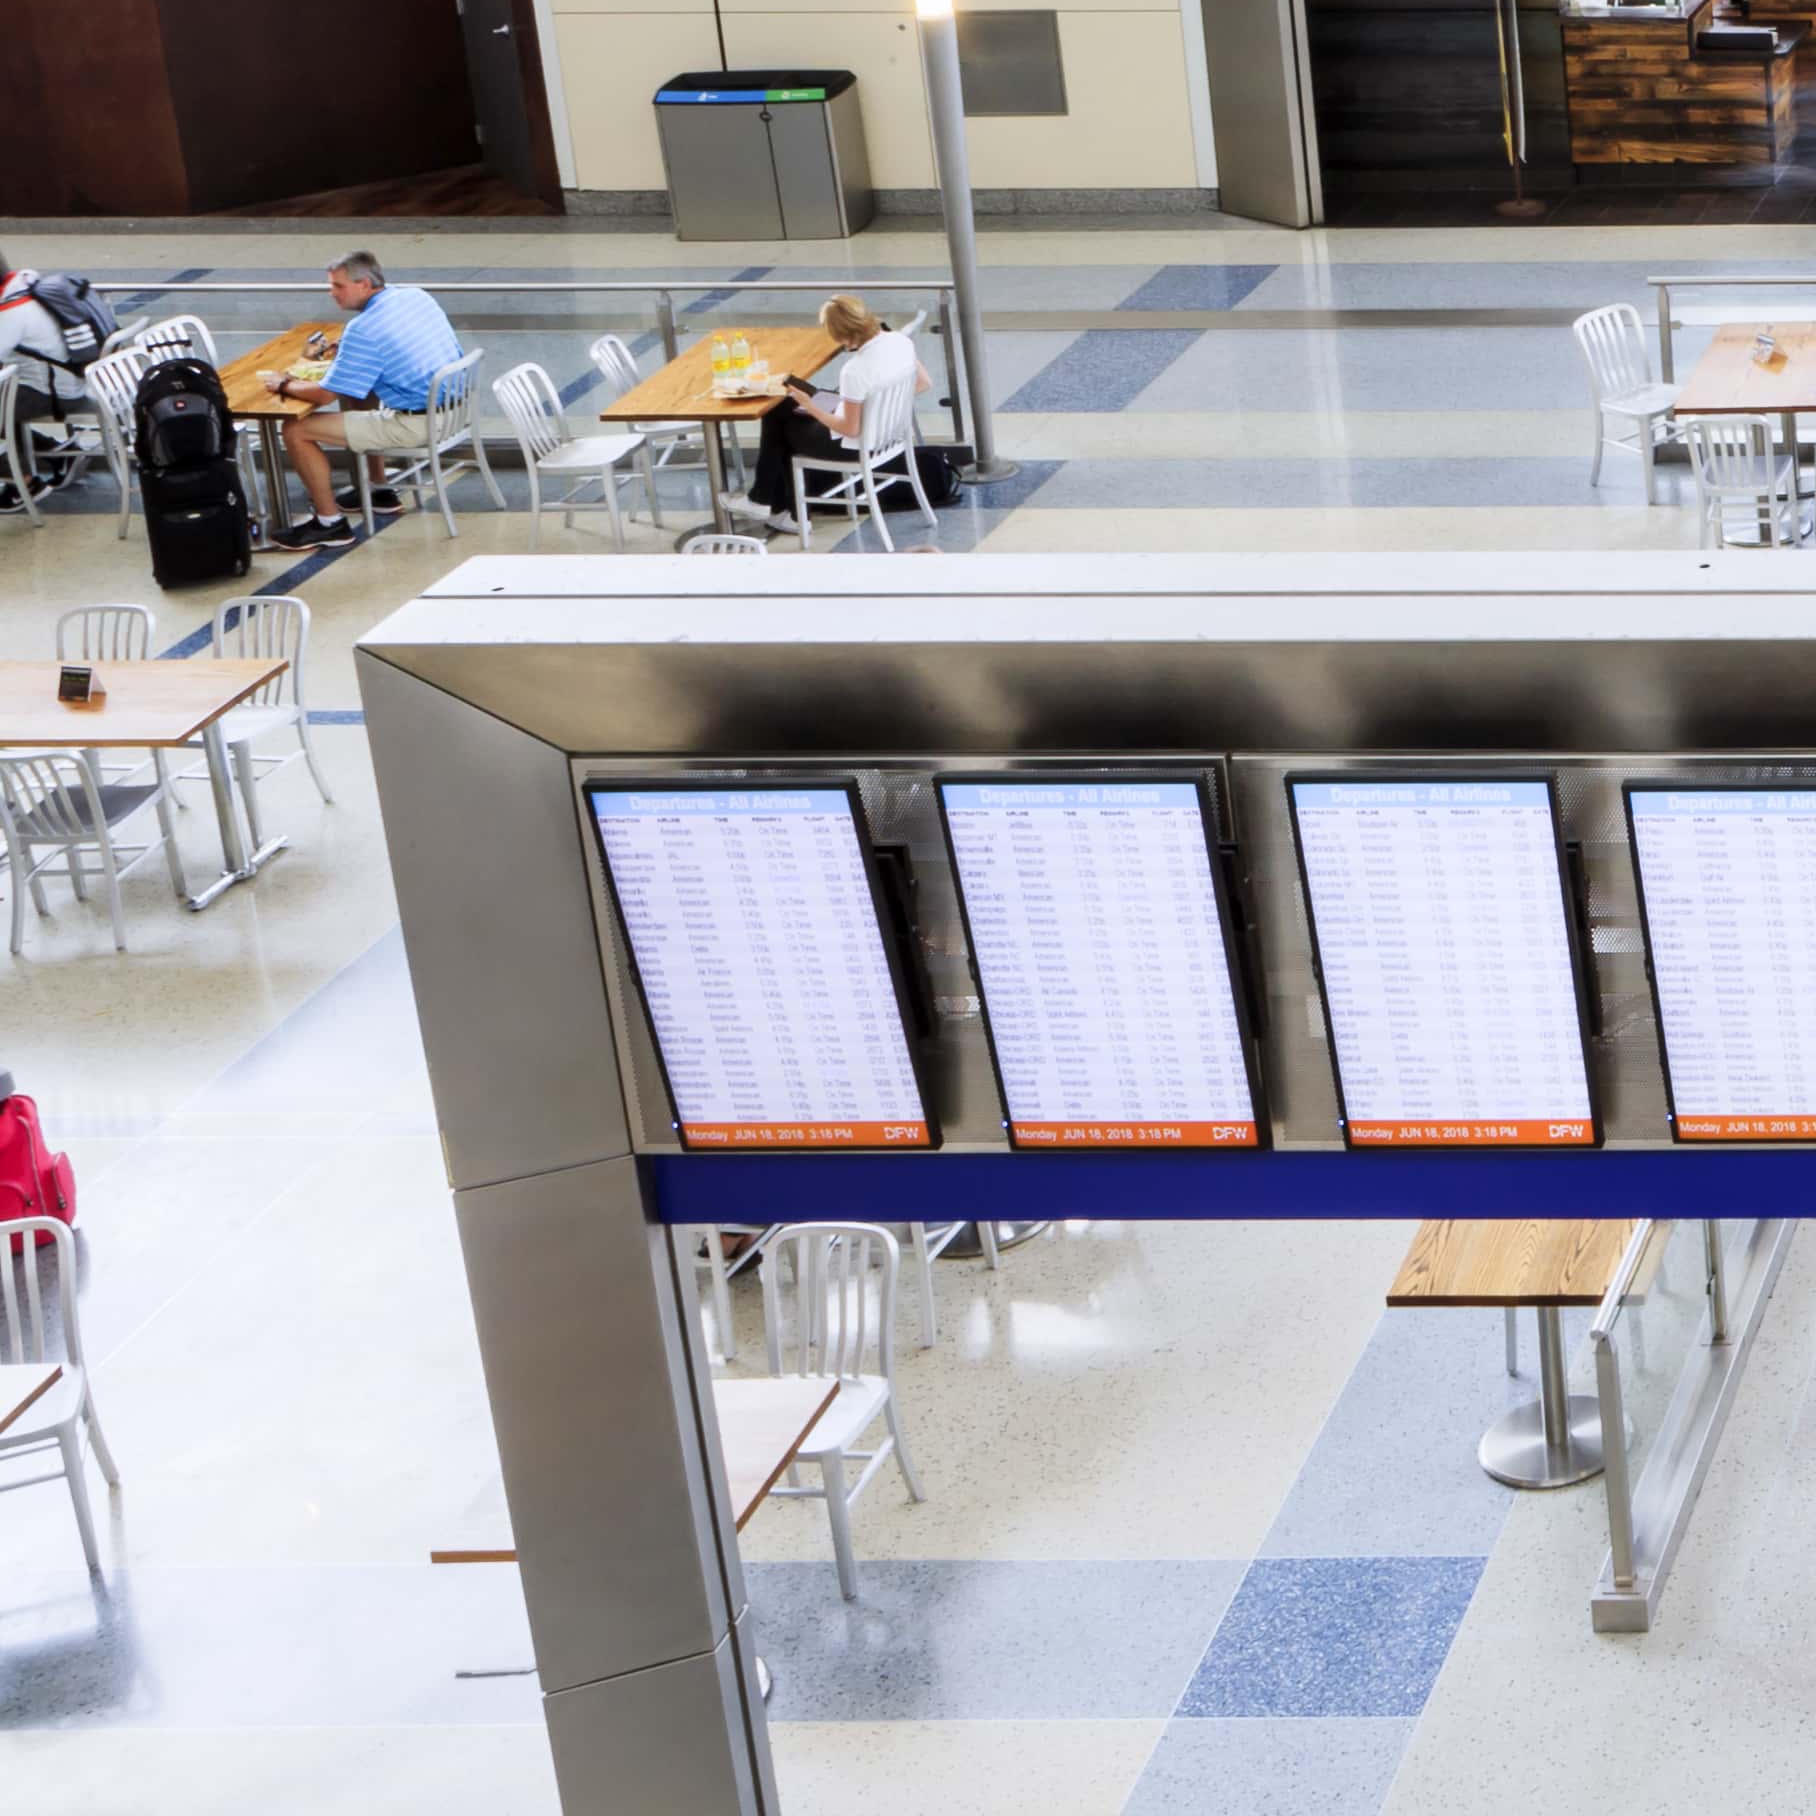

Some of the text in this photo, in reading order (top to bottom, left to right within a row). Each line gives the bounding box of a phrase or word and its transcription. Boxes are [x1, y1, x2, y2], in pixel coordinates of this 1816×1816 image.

[980, 788, 1160, 805] Departures All Airlines
[1330, 787, 1511, 805] Departures All Airlines
[630, 795, 810, 812] Departures All Airlines
[1668, 796, 1752, 812] Departures
[1766, 796, 1786, 809] All
[883, 1126, 919, 1140] DFW
[1016, 1129, 1057, 1141] Monday
[1063, 1129, 1086, 1140] JUN
[1106, 1129, 1133, 1140] 2018
[1139, 1128, 1161, 1140] 3:18
[1163, 1128, 1182, 1139] PM
[1212, 1126, 1248, 1140] DFW
[1351, 1128, 1393, 1140] Monday
[1399, 1127, 1422, 1138] JUN
[1442, 1127, 1470, 1138] 2018
[1474, 1126, 1496, 1138] 3:18
[1498, 1126, 1518, 1138] PM
[1548, 1124, 1584, 1139] DFW
[1679, 1122, 1721, 1134] Monday
[1727, 1122, 1750, 1133] JUN
[1771, 1121, 1797, 1132] 2018
[687, 1131, 728, 1142] Monday
[735, 1130, 757, 1140] JUN
[779, 1130, 804, 1140] 2018
[811, 1129, 833, 1139] 3:18
[835, 1129, 853, 1139] PM
